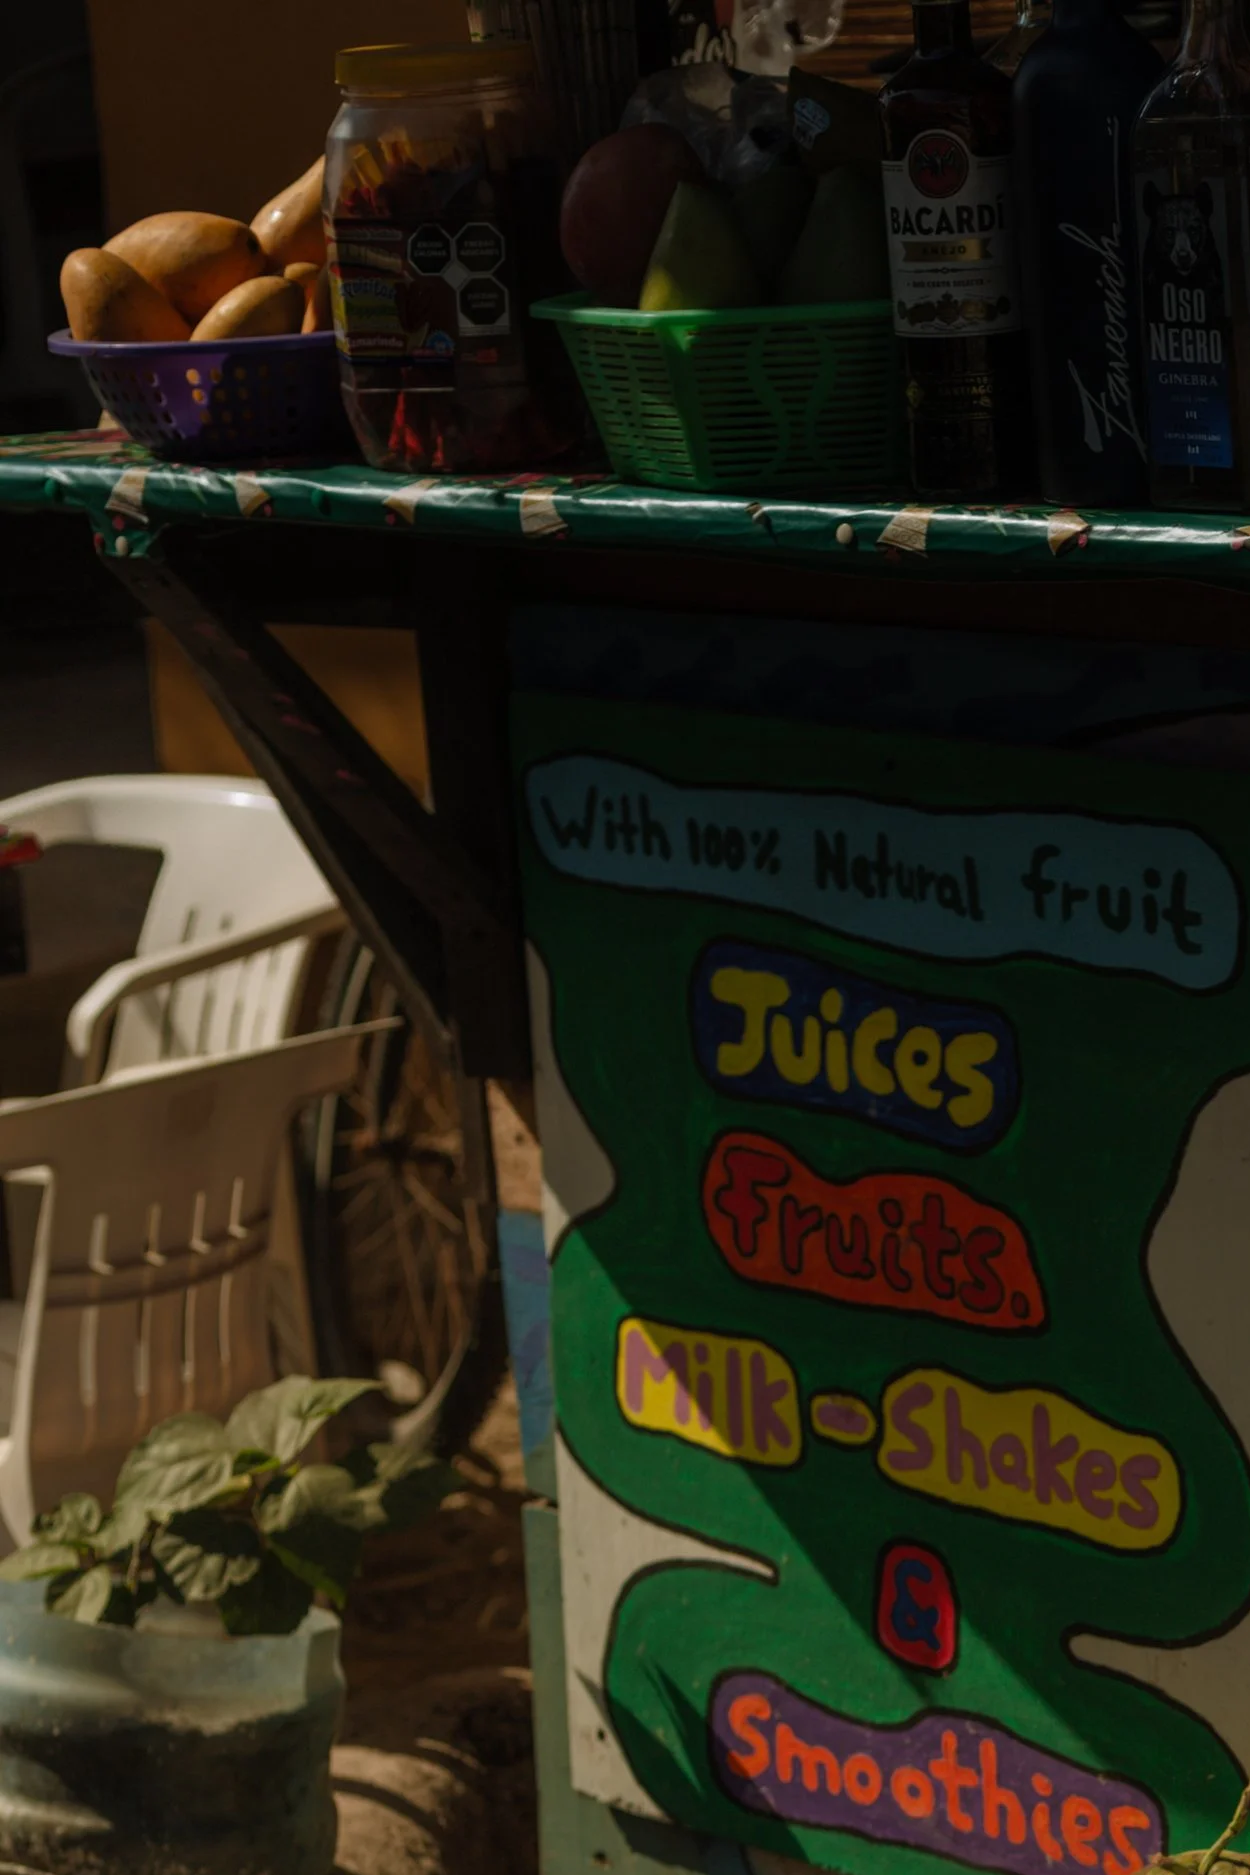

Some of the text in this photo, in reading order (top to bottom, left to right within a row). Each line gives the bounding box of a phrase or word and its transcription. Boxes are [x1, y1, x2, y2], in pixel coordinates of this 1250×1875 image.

[1149, 321, 1223, 365] NEGRO
[1157, 371, 1219, 388] GINEBRA
[540, 786, 672, 860] With
[687, 818, 783, 877] 100%
[815, 828, 985, 922] Natural
[709, 966, 1000, 1128] Juices
[889, 1558, 942, 1652] &
